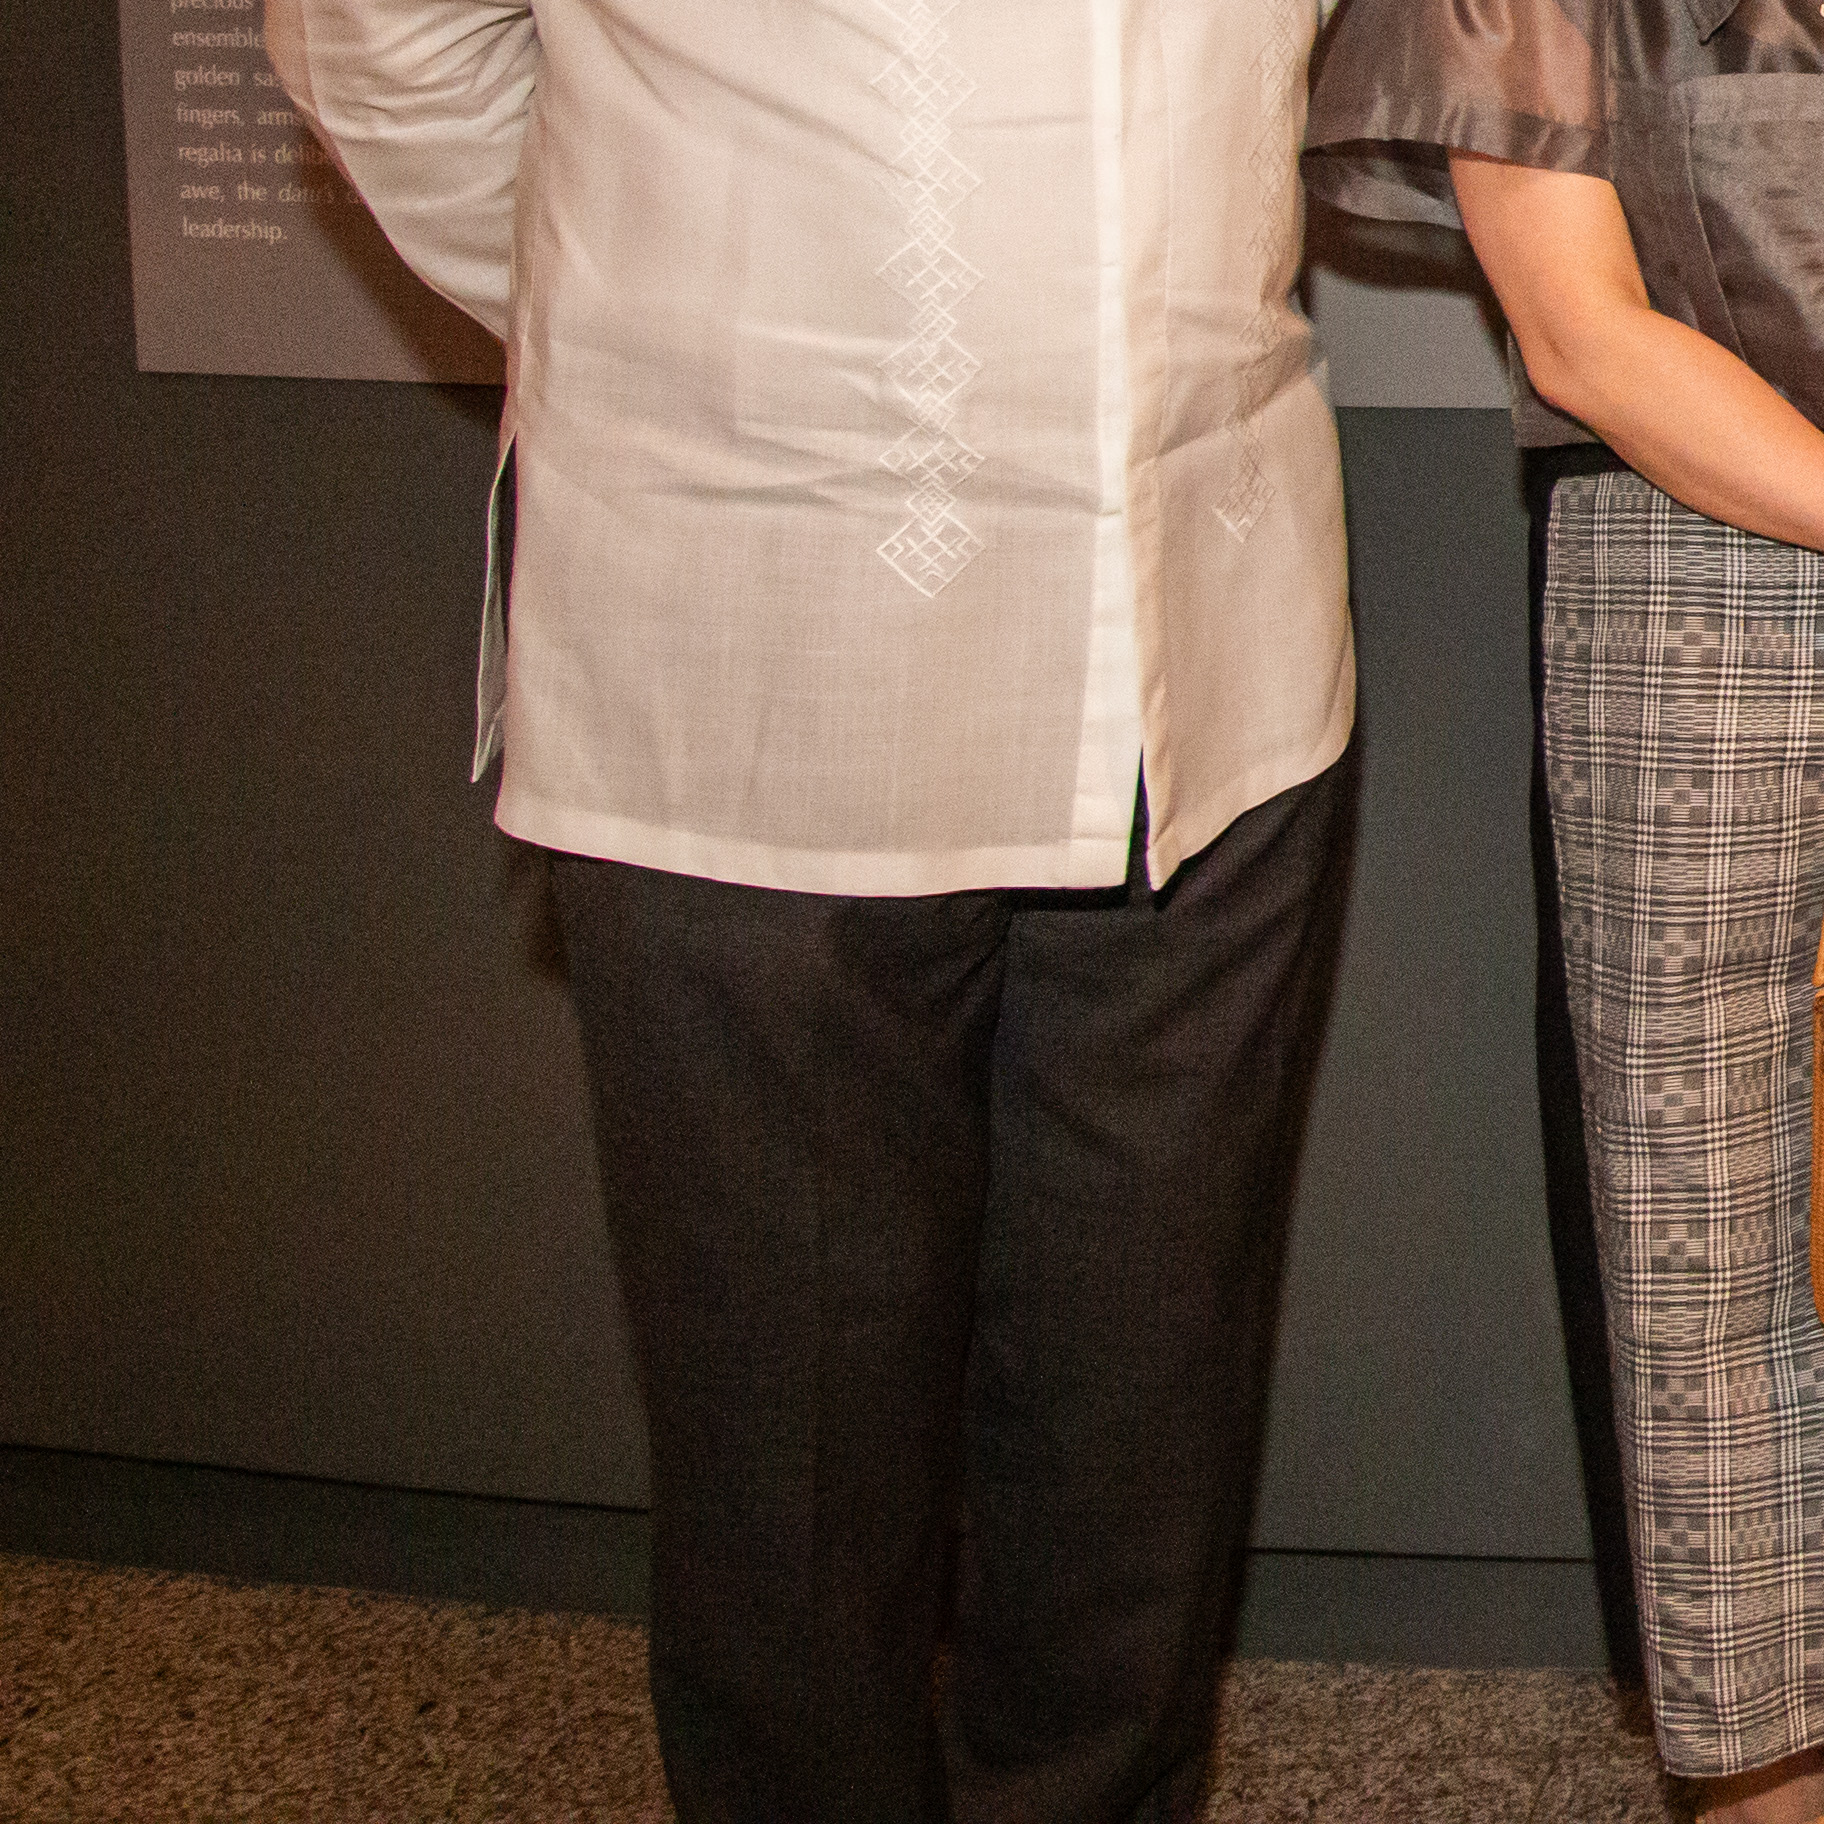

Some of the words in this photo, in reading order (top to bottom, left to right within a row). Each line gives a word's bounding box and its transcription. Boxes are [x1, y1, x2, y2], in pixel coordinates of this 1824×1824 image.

[174, 64, 240, 92] golden
[178, 142, 243, 168] regalia
[249, 143, 268, 164] is
[179, 184, 226, 204] awe,
[237, 180, 268, 202] the
[182, 216, 289, 245] leadership.
